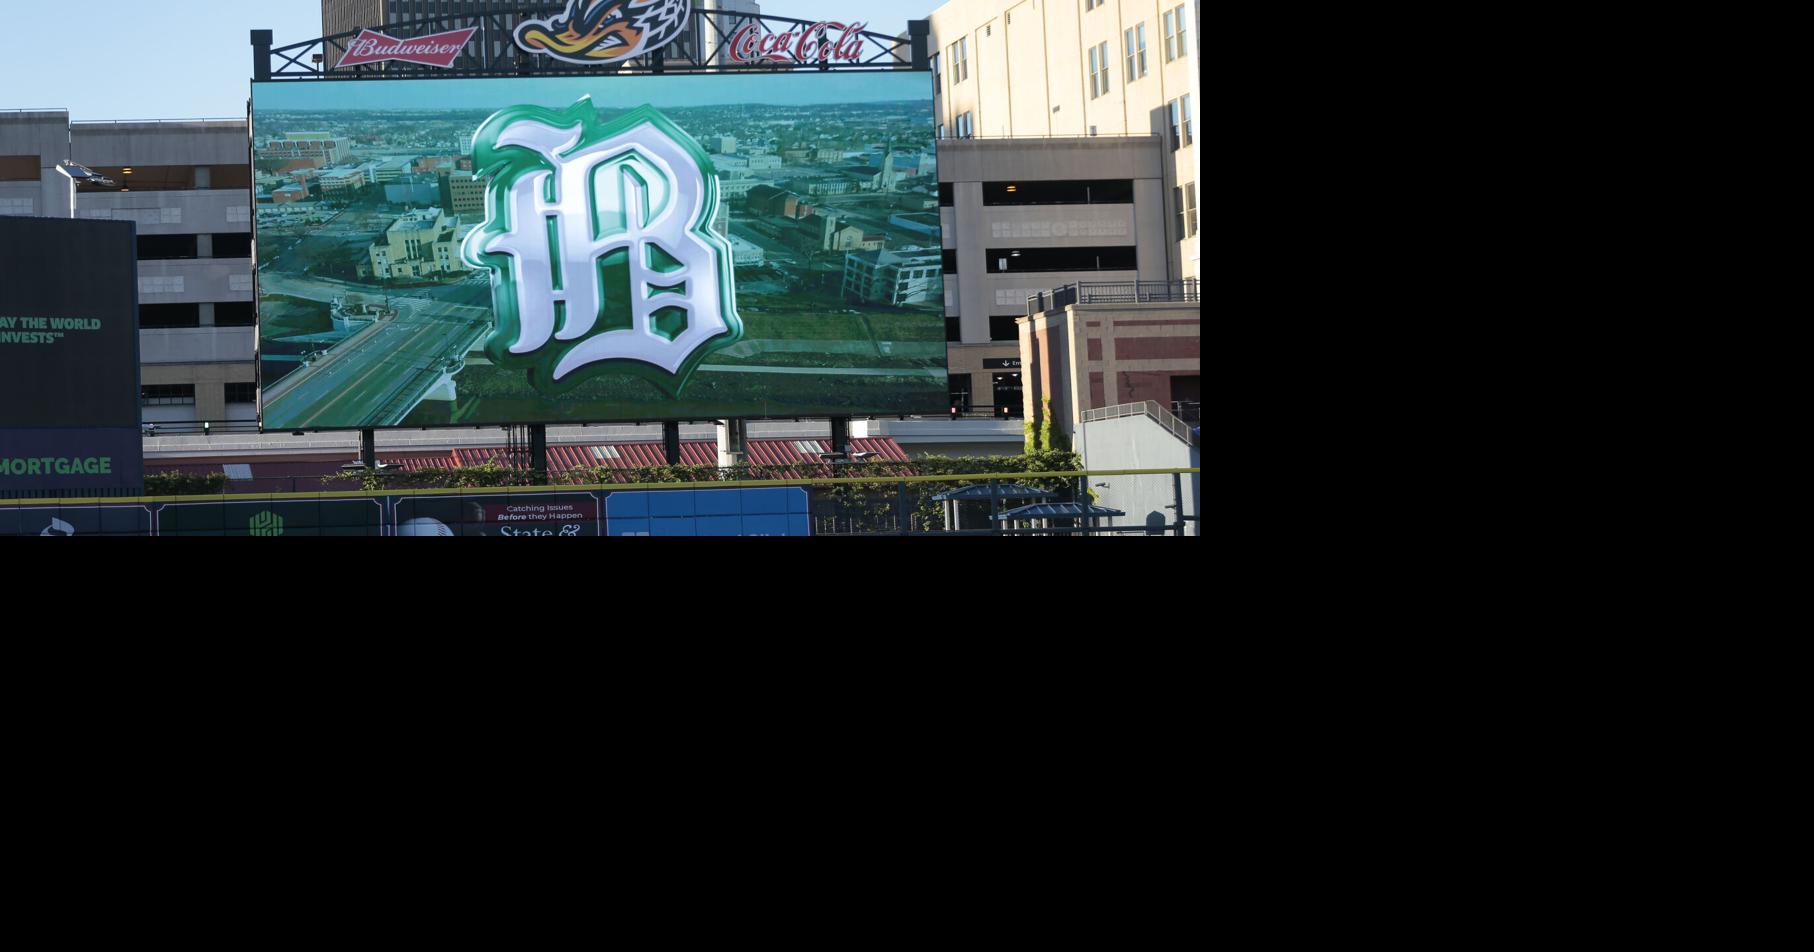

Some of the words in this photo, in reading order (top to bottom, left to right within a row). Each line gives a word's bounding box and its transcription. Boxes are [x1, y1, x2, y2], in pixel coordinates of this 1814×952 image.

[348, 38, 462, 57] Budweiser
[729, 21, 868, 62] Coca-Cola
[20, 317, 47, 329] THE
[50, 317, 101, 330] WORLD
[506, 505, 545, 513] Catching
[497, 513, 527, 521] Before
[528, 512, 548, 521] they
[548, 512, 583, 520] Happen
